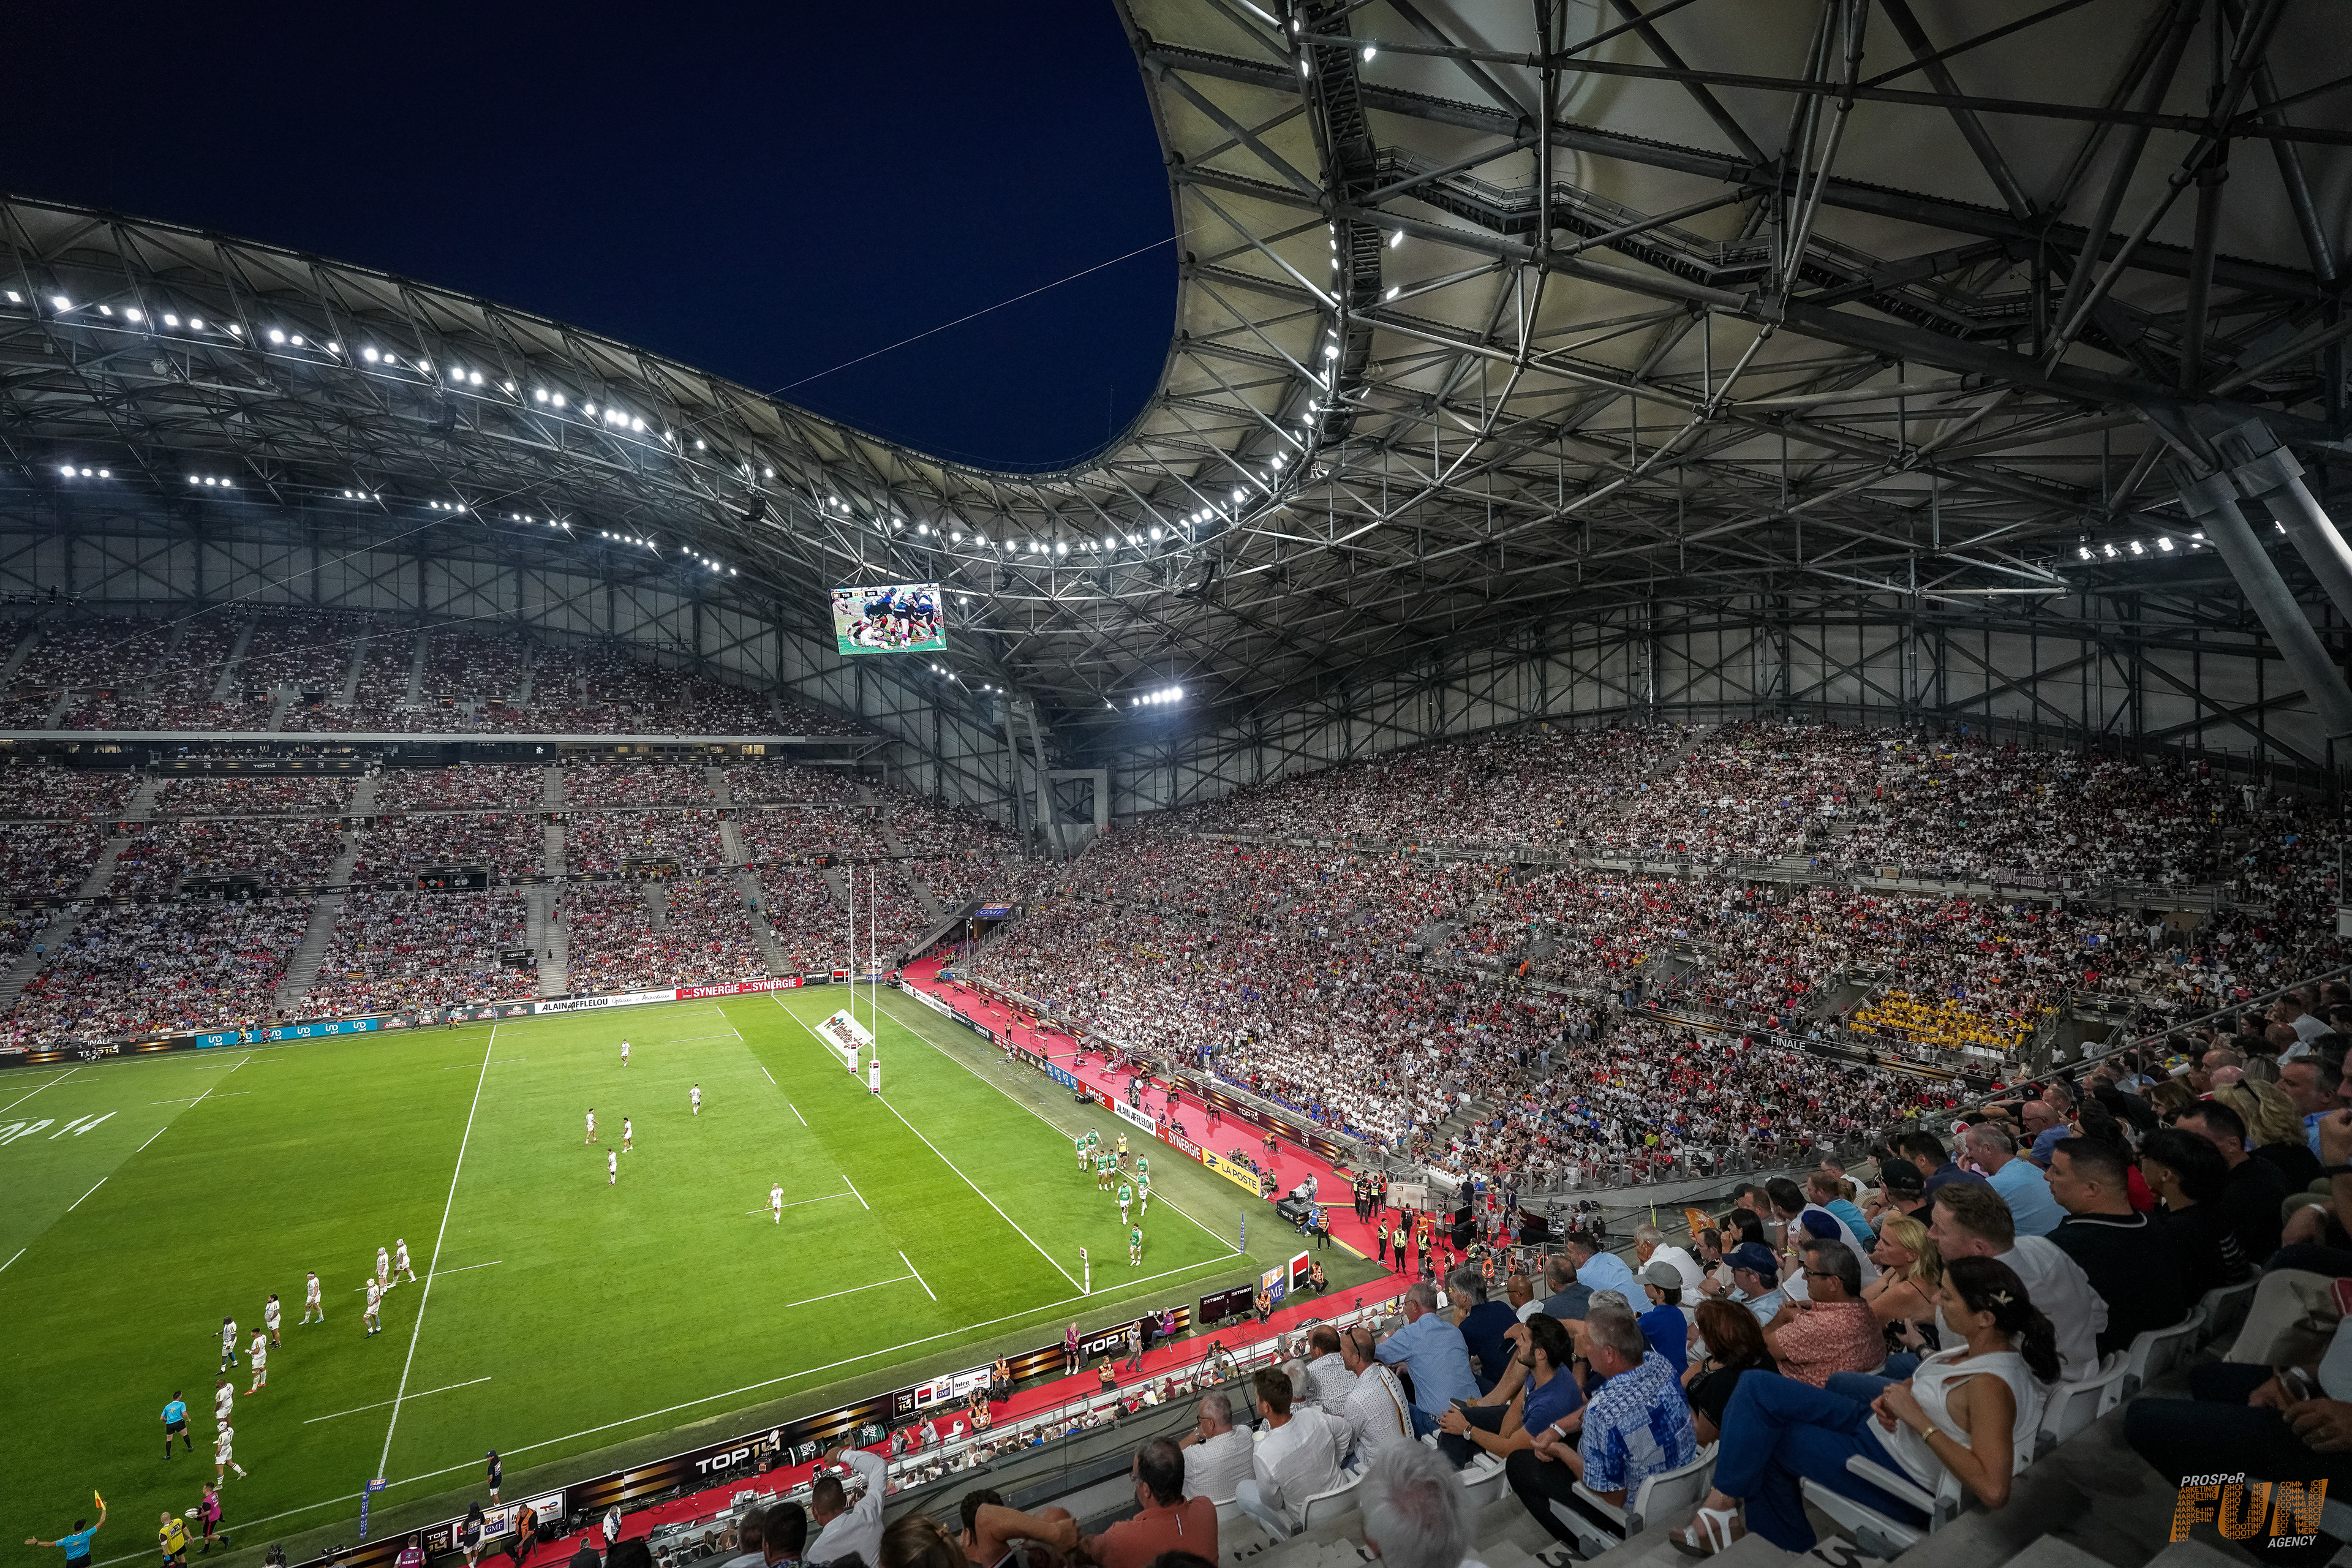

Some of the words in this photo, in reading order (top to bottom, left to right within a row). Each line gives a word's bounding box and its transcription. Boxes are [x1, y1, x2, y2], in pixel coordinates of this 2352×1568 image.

[2014, 876, 2045, 888] UNION
[693, 984, 740, 997] SYNERGIE
[542, 1002, 567, 1011] ALAIN
[571, 998, 608, 1009] AFFLELOU
[1771, 1036, 1806, 1050] FINALE
[1086, 1085, 1106, 1105] Betclic
[1117, 1104, 1130, 1118] ALAIN
[1131, 1112, 1153, 1131] AFFLELOU
[1238, 1107, 1259, 1122] TOP14
[0, 1118, 55, 1145] OP
[1168, 1131, 1202, 1161] SYNERGIE
[1222, 1163, 1232, 1176] LA
[1232, 1169, 1257, 1190] POSTE
[937, 1389, 949, 1398] GMF
[898, 1400, 912, 1412] 14
[696, 1438, 780, 1474] TOP14
[486, 1523, 503, 1533] GMF
[427, 1531, 448, 1540] TOP
[428, 1539, 447, 1552] 14
